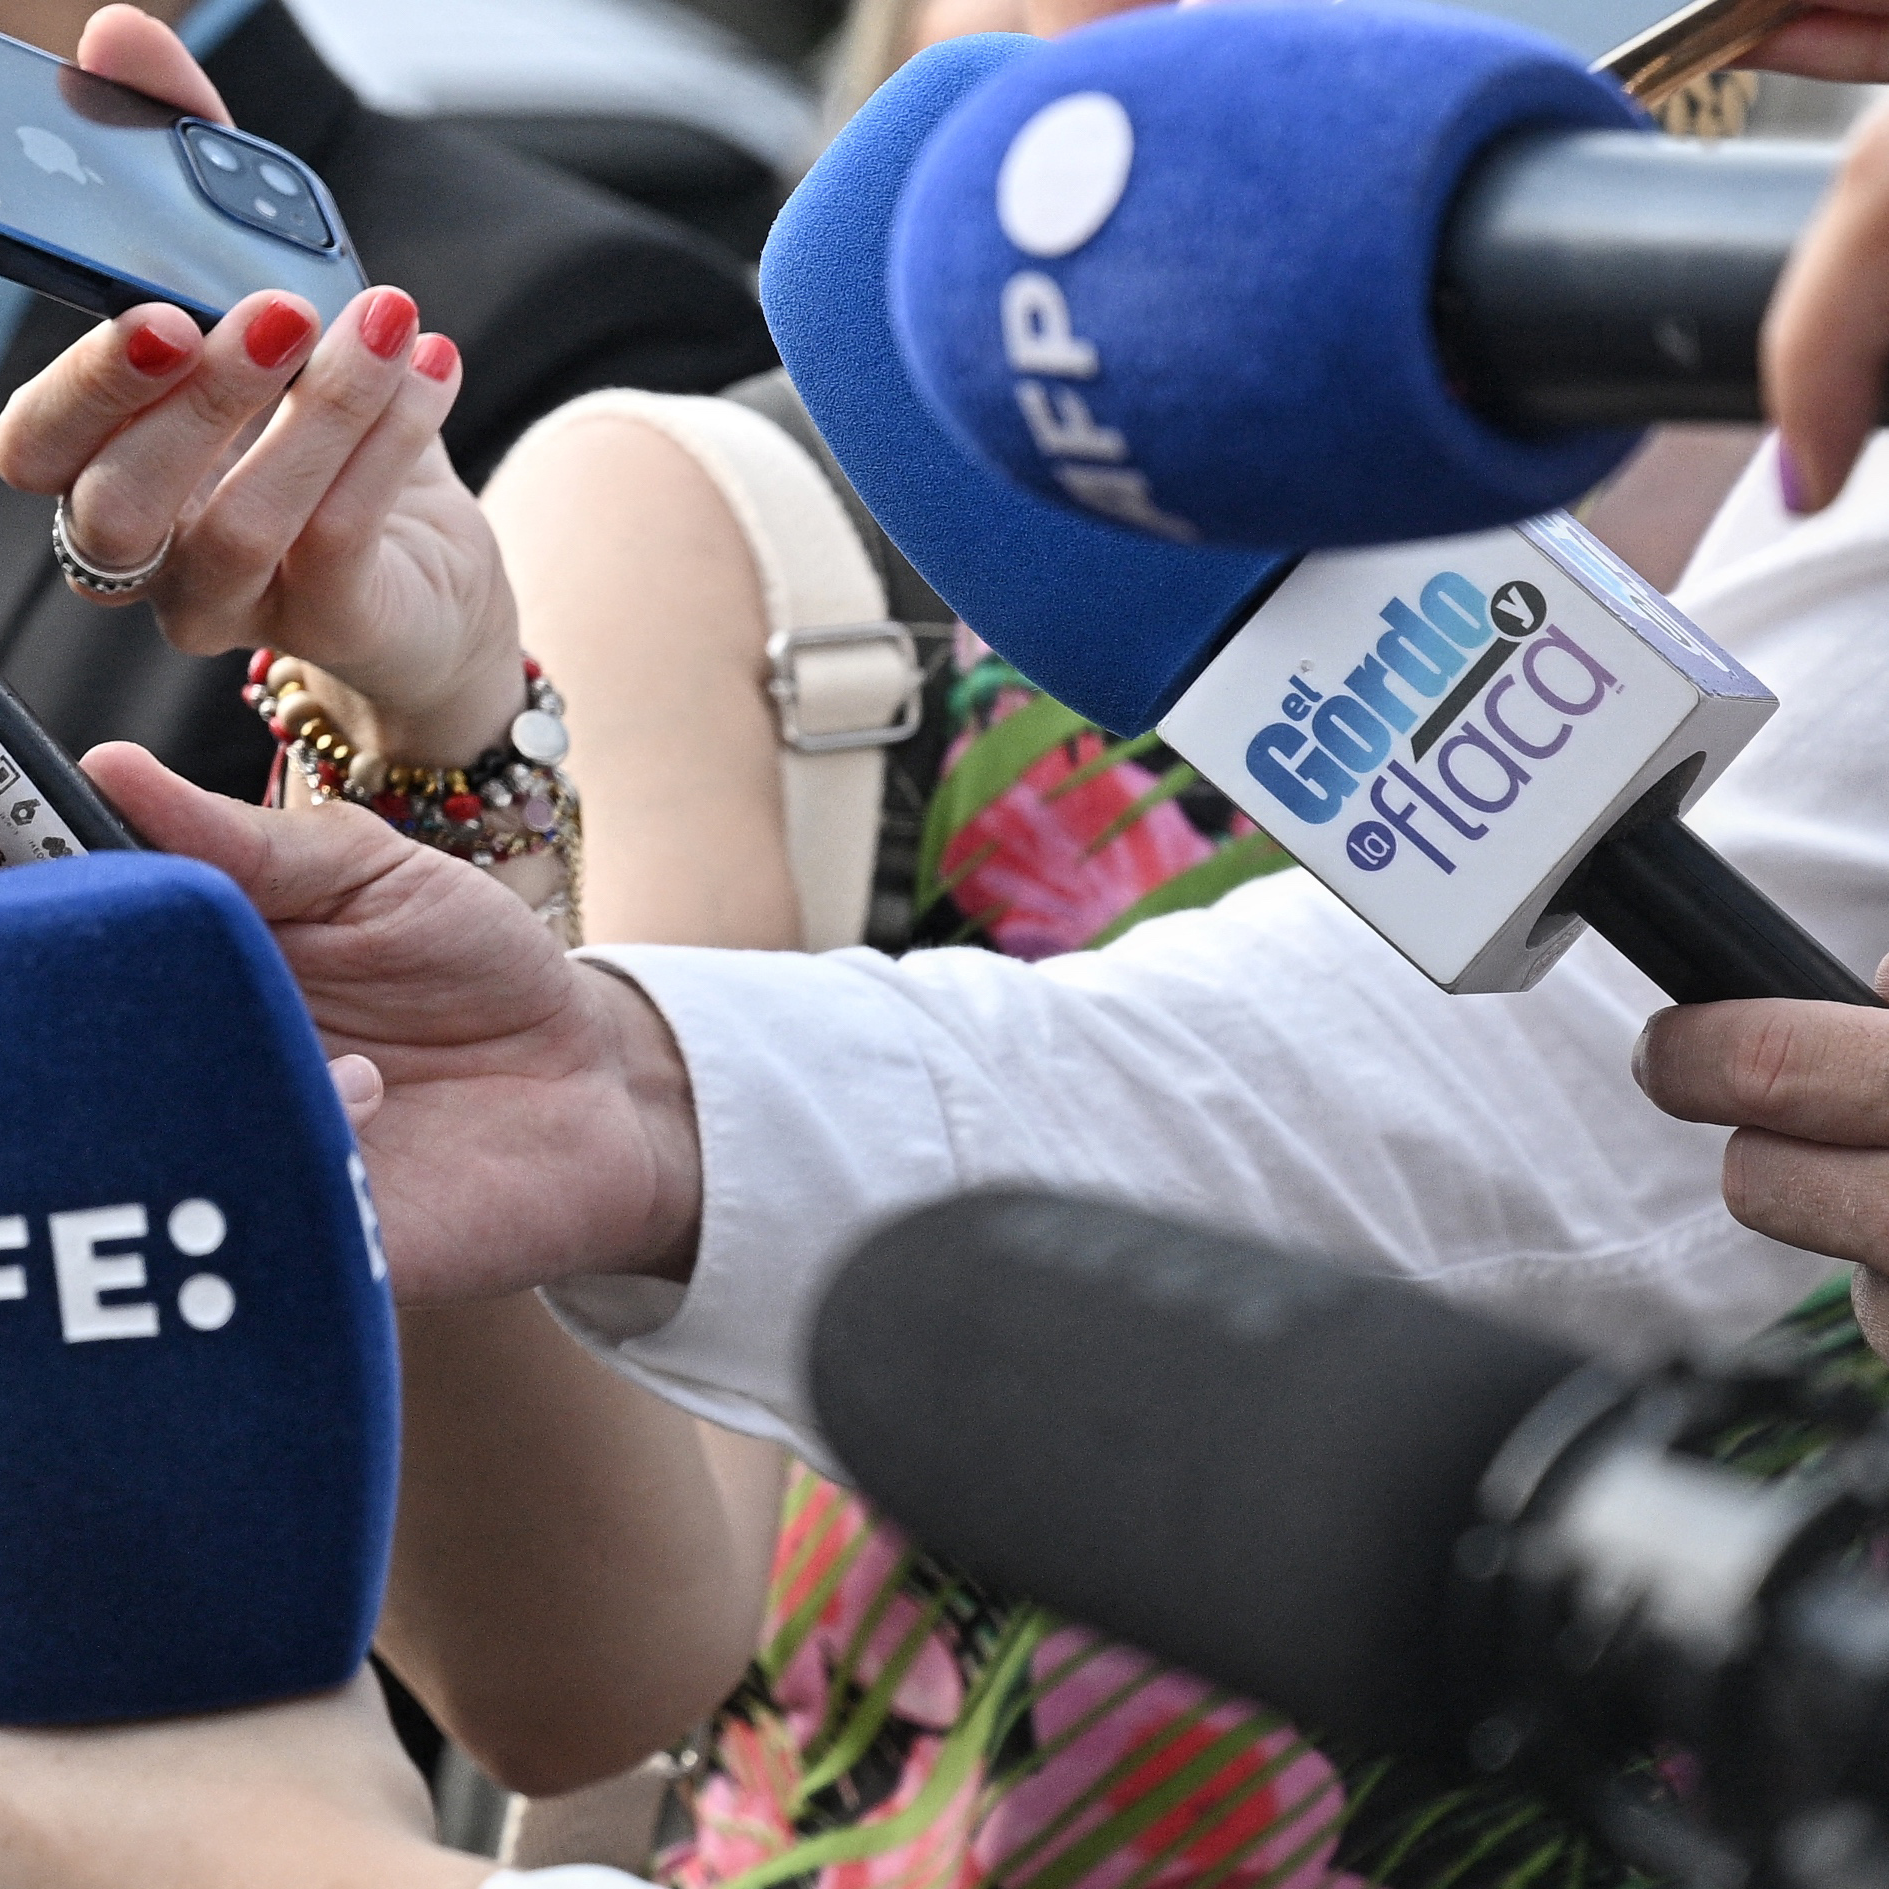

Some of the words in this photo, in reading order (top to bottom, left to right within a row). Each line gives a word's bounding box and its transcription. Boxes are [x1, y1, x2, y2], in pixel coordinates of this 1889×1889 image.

[1000, 269, 1200, 544] AFP
[1494, 585, 1537, 631] y
[1245, 571, 1495, 824] Gordo
[1282, 674, 1323, 723] el
[1368, 623, 1619, 875] flaca
[1350, 830, 1392, 866] la
